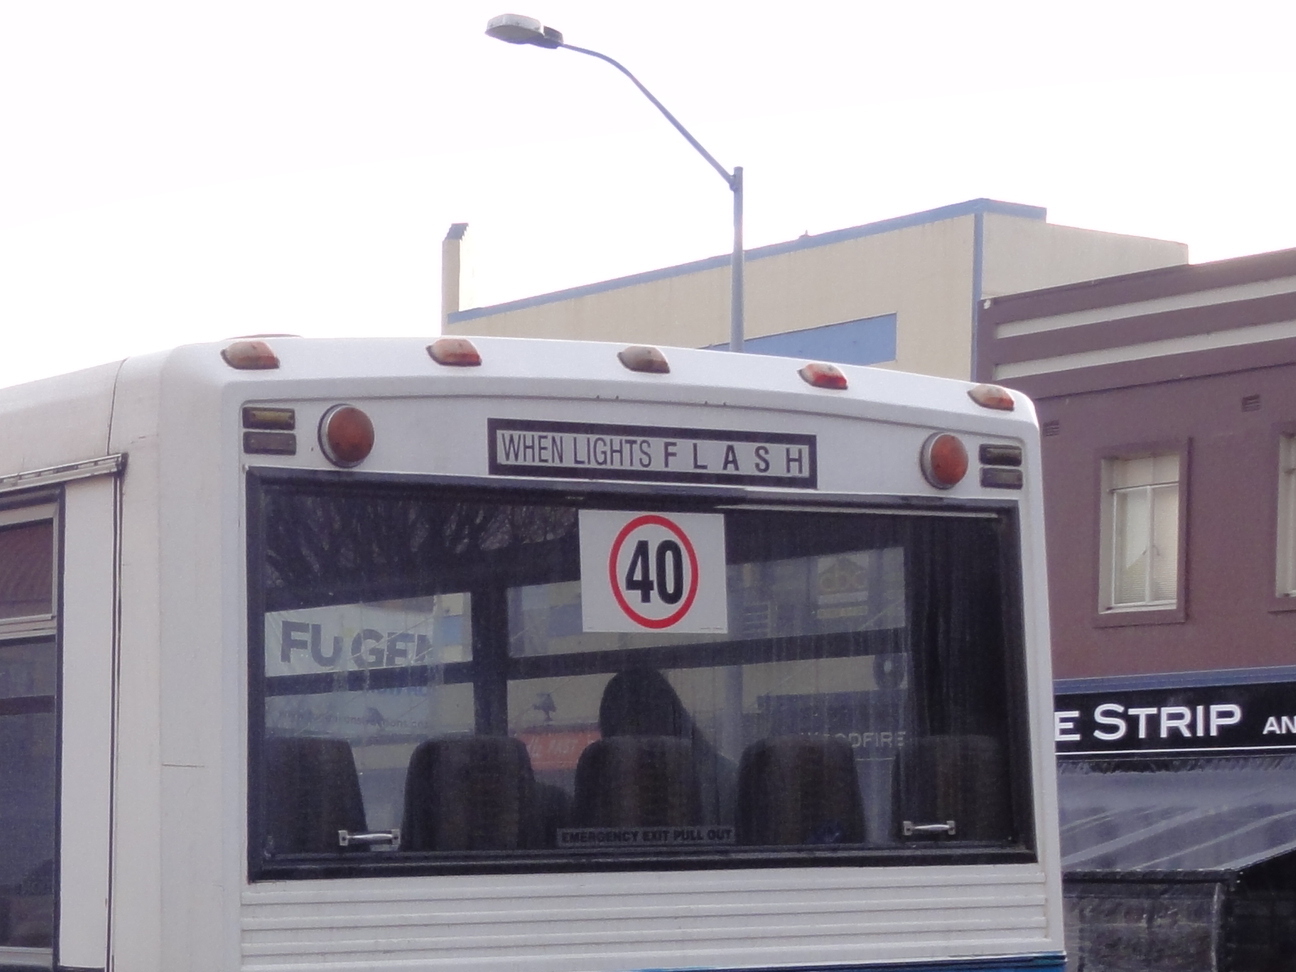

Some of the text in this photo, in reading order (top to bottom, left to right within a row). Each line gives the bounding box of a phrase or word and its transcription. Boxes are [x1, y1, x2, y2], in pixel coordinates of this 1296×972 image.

[501, 432, 804, 474] WHEN LIGHTS FLASH
[625, 540, 684, 605] 40
[1093, 703, 1243, 740] STRIP
[1262, 716, 1296, 734] AN
[560, 829, 733, 844] EMERGENCY EXIT PULL OUT
